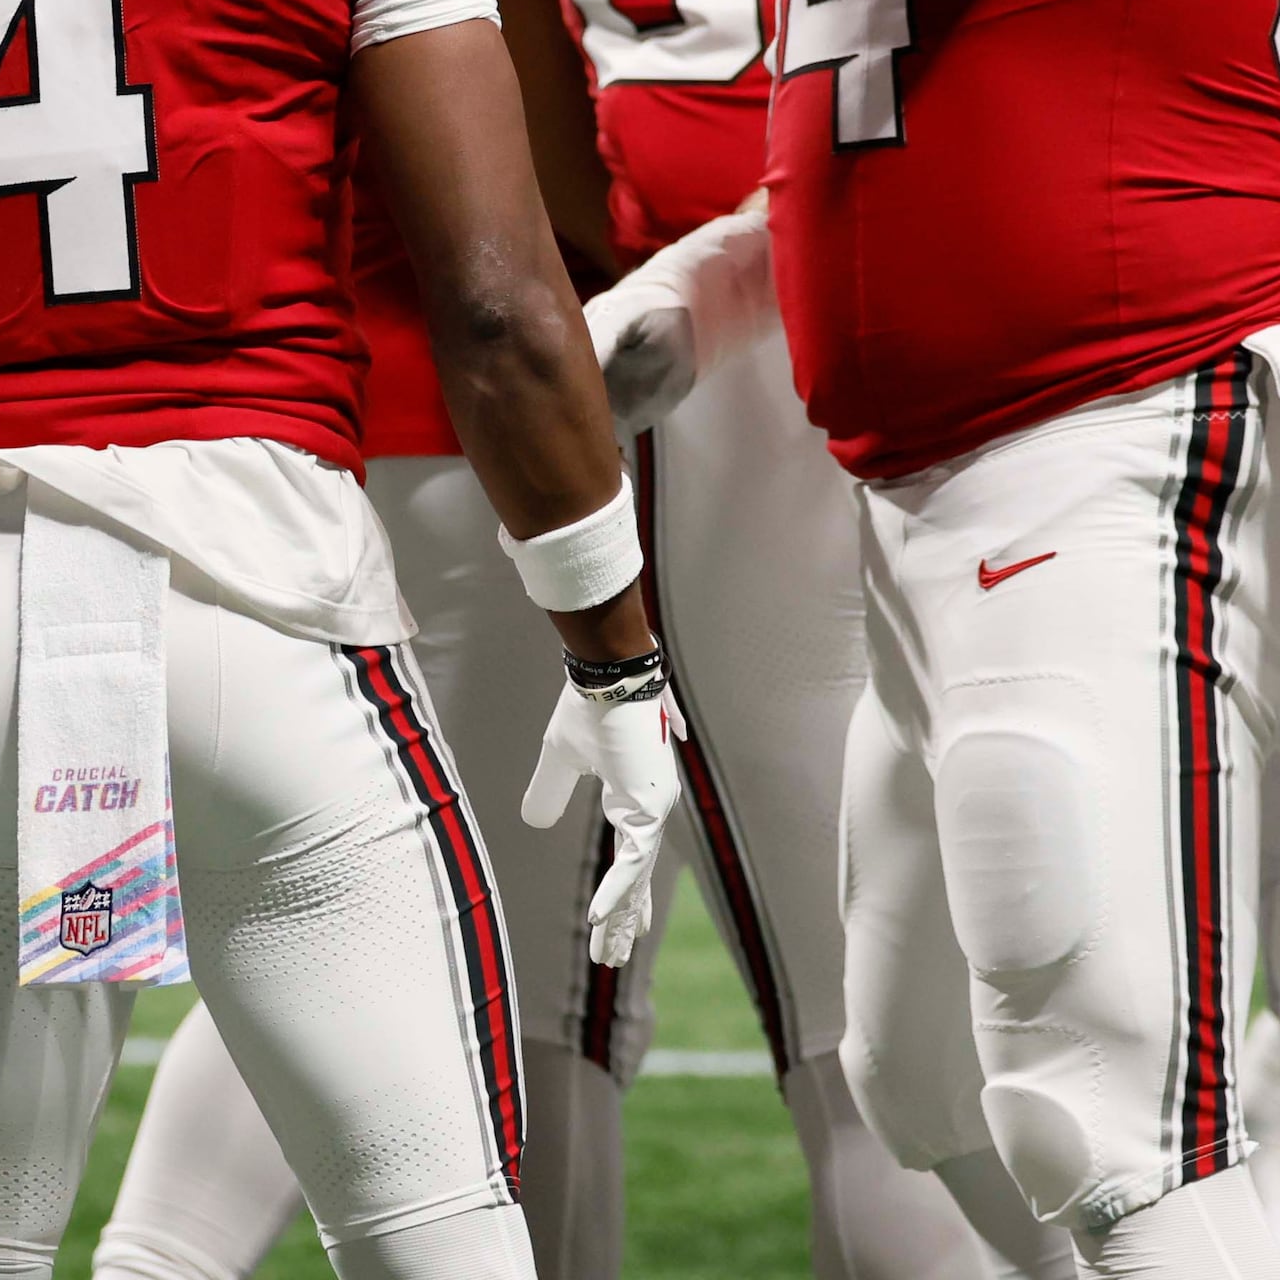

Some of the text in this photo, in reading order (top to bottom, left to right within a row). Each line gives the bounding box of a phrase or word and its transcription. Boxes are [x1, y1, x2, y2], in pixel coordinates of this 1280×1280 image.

[602, 686, 627, 702] BE
[52, 766, 129, 782] CRUCIAL
[34, 778, 141, 814] CATCH
[64, 912, 107, 946] NFL
